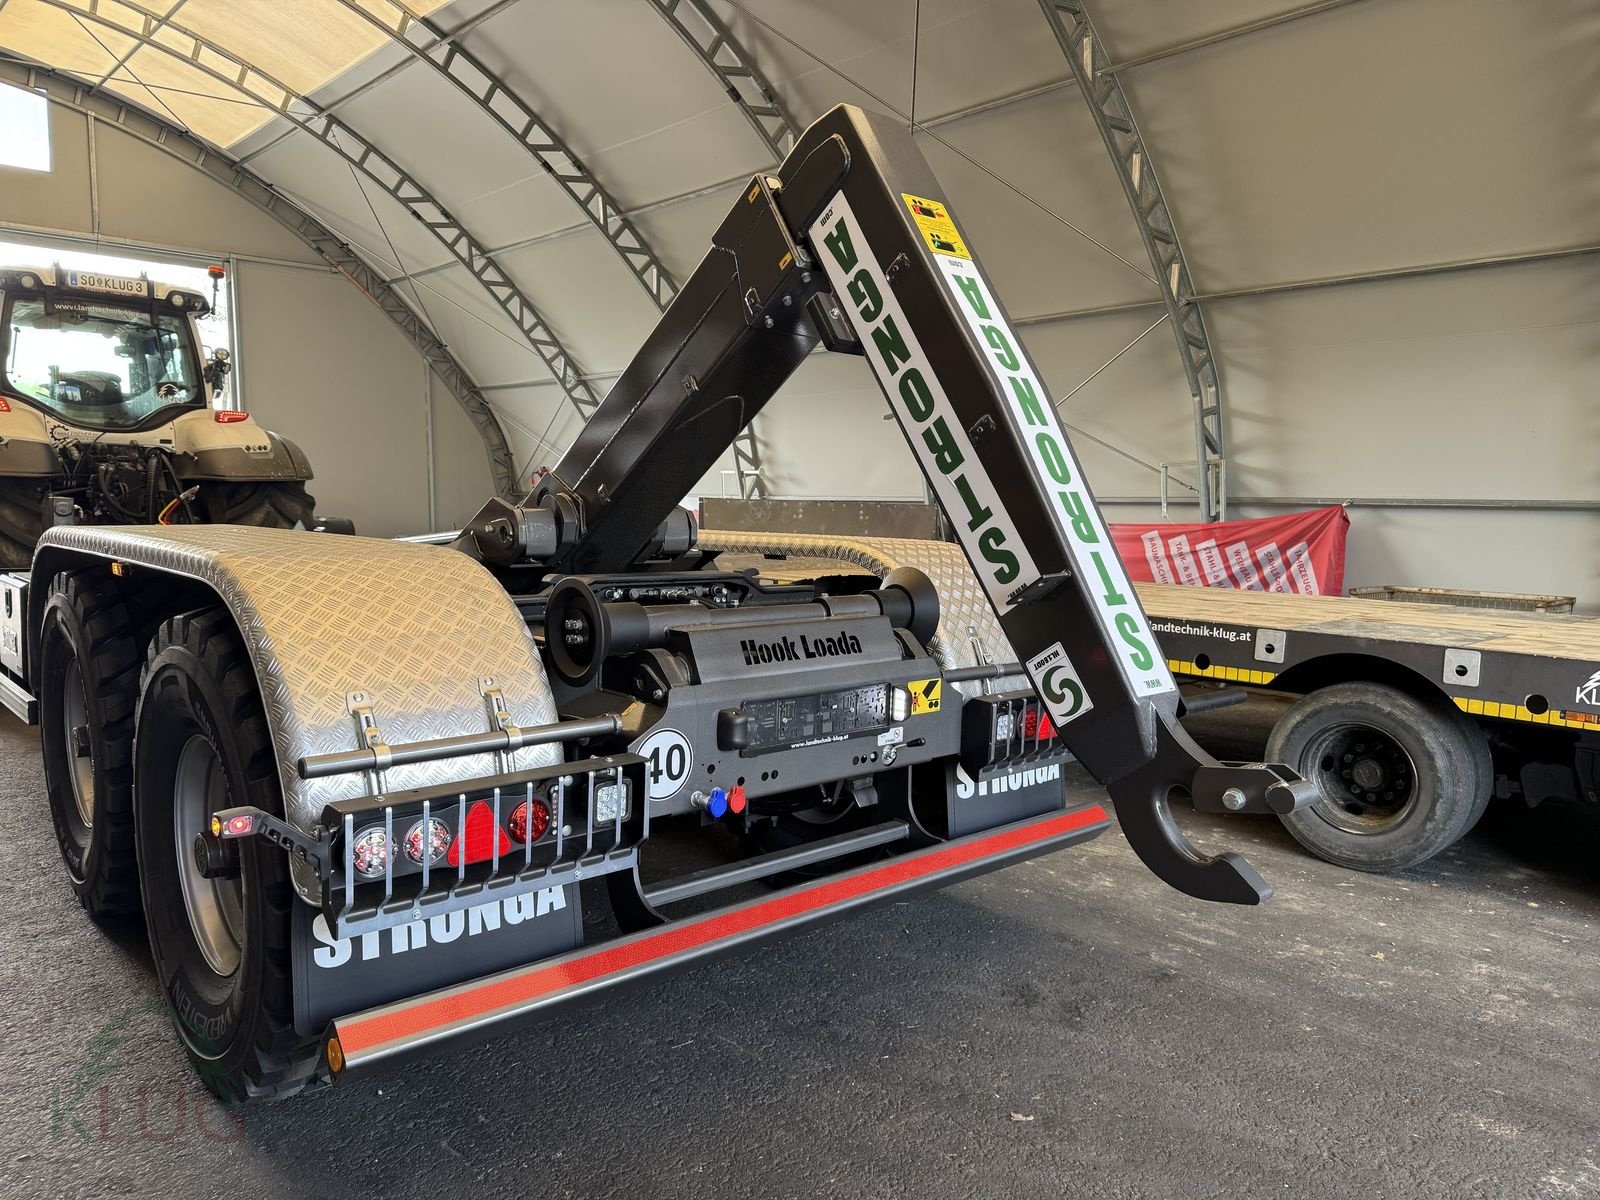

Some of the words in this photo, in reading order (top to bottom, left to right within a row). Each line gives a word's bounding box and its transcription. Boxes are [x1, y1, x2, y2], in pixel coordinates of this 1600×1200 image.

[820, 206, 833, 227] .com
[80, 274, 95, 287] SO
[104, 278, 134, 292] KLUG
[135, 283, 143, 293] 3
[823, 215, 1020, 585] STRONGA
[952, 274, 1154, 672] STRONGA
[1233, 548, 1252, 583] WEINBAU
[740, 635, 801, 666] Hook
[799, 630, 863, 659] Loada
[649, 743, 686, 785] 40
